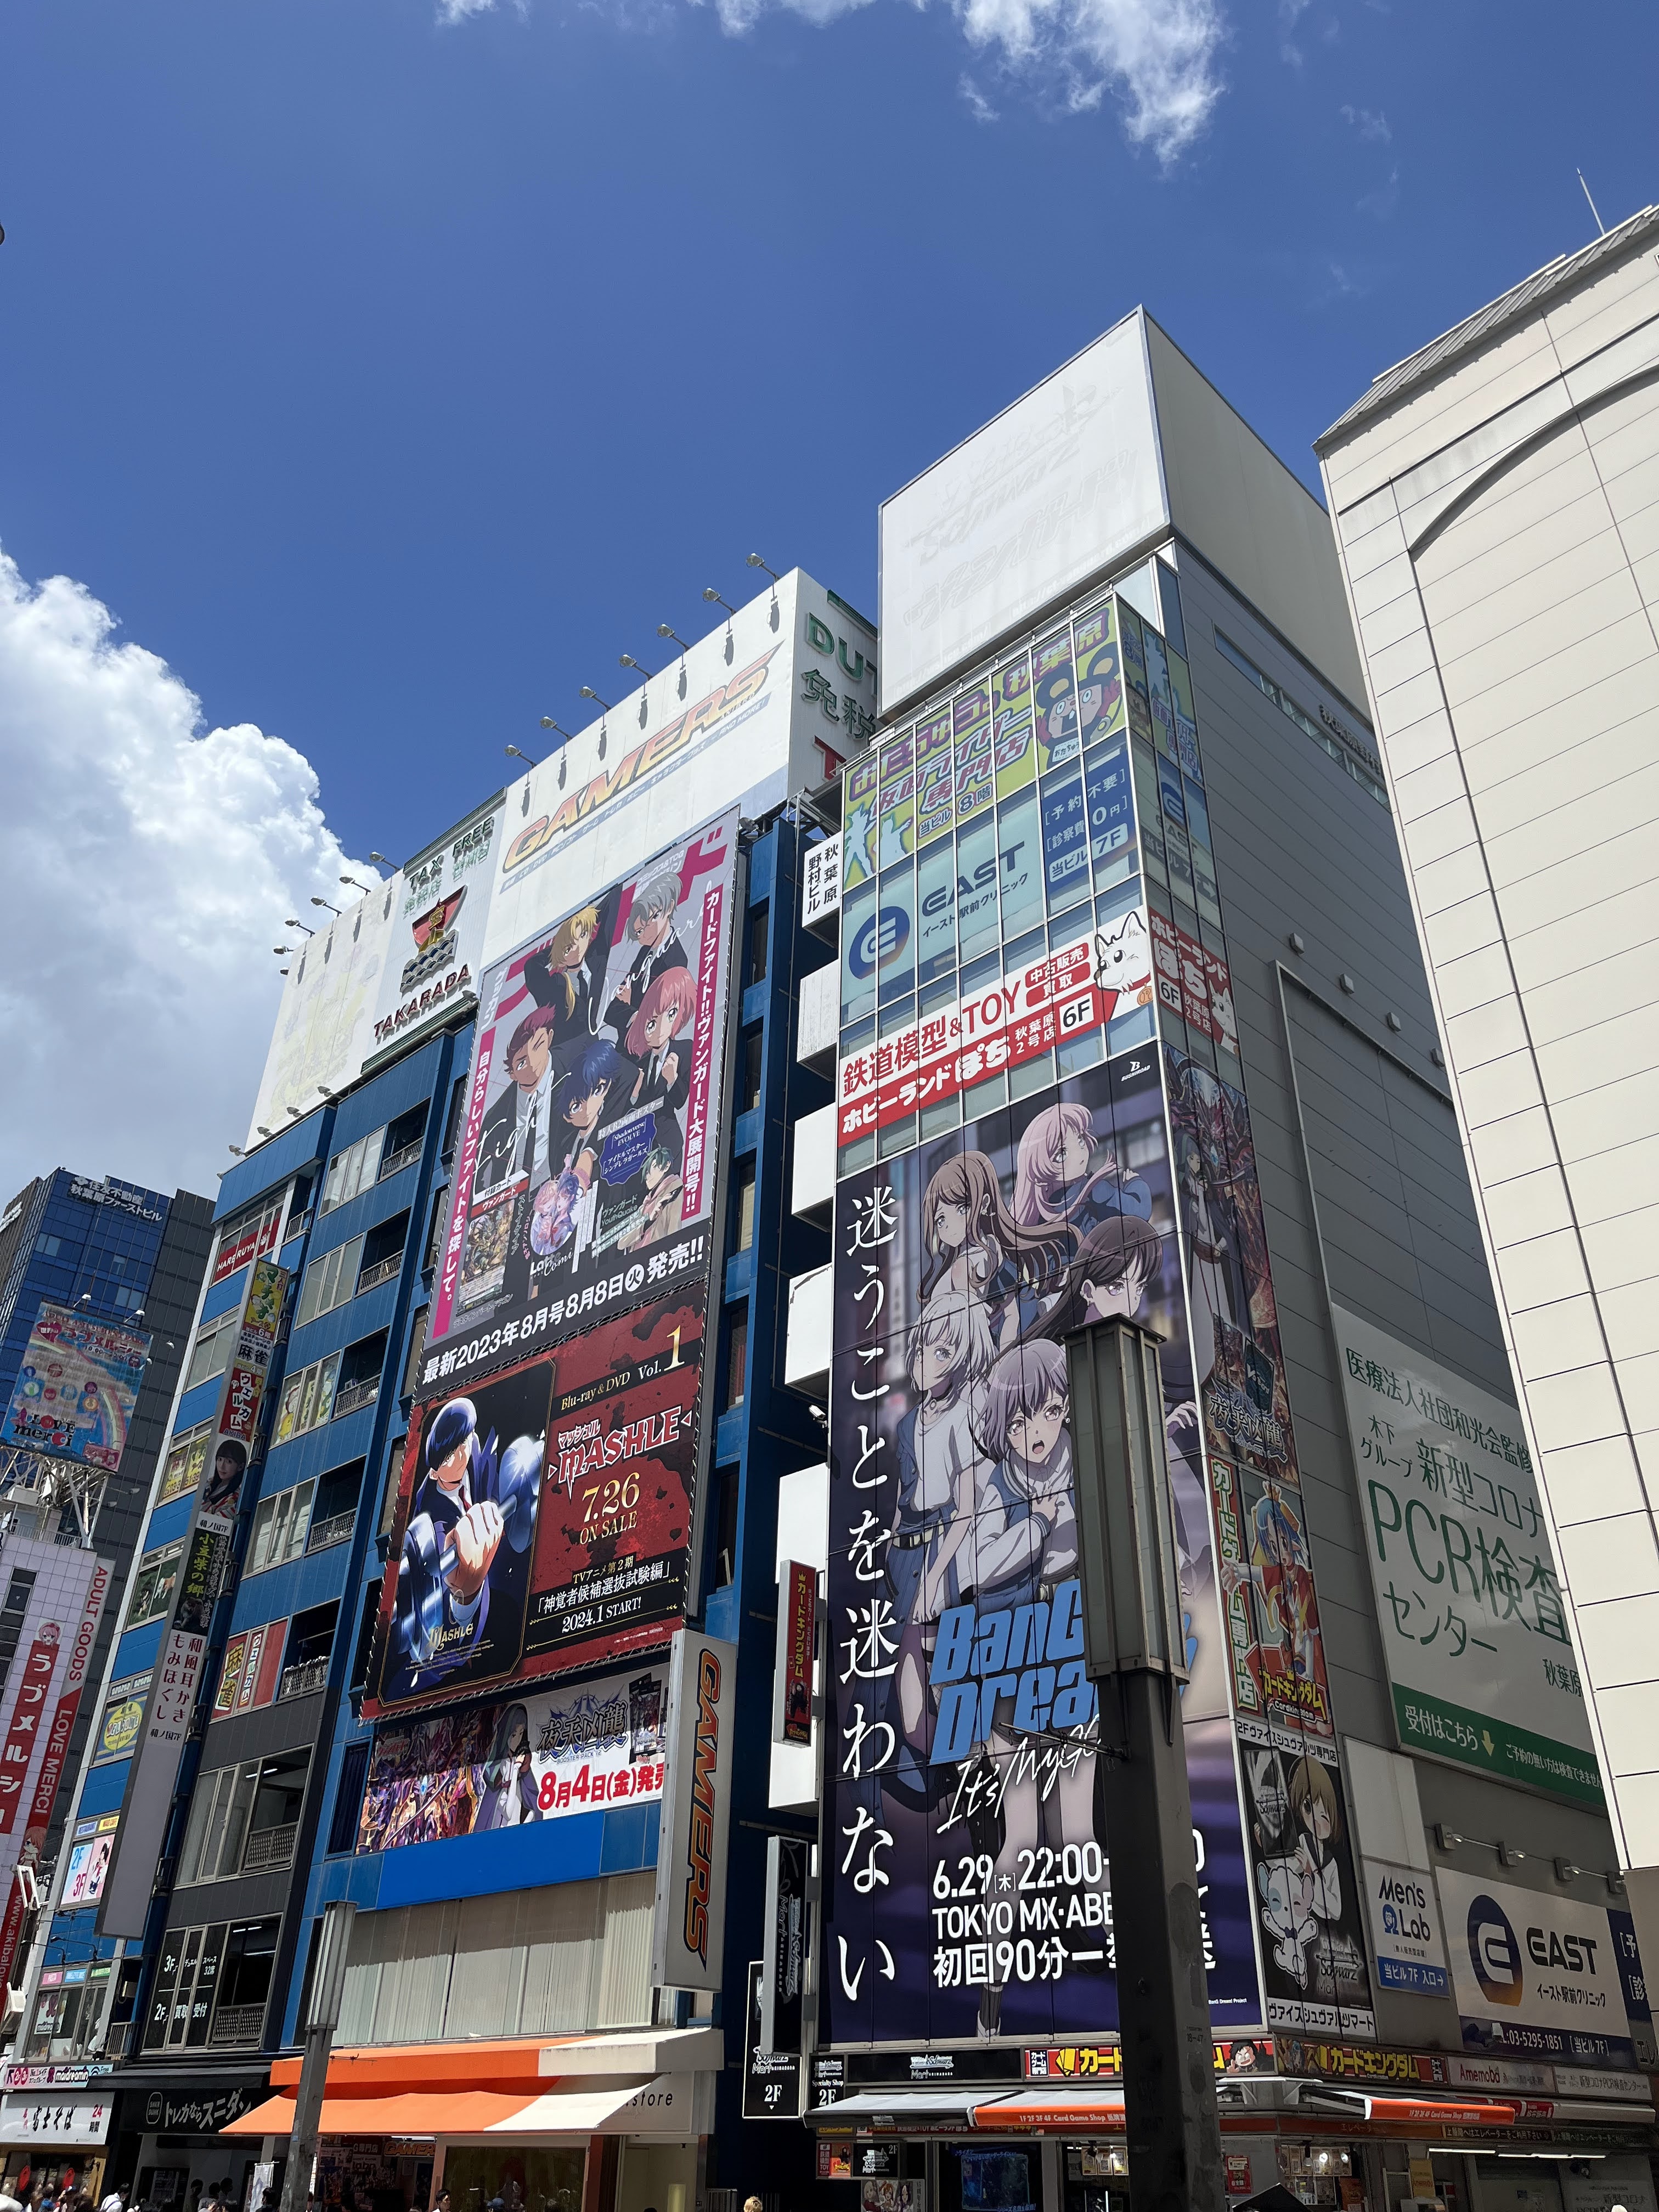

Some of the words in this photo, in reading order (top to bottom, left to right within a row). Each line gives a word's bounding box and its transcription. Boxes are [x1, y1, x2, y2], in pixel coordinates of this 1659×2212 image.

[1007, 613, 1106, 696] 秋葉原
[504, 640, 786, 874] GAMERS
[874, 708, 1032, 817] 仮面ライダー
[923, 728, 1030, 813] 専門店
[919, 810, 952, 837] 当ビル
[958, 783, 992, 815] 8階
[410, 854, 442, 889] TAX
[452, 815, 493, 858] FREE
[534, 854, 549, 868] DVD
[583, 820, 599, 834] ゲーム
[605, 799, 624, 816] トレカ
[823, 842, 839, 905] 秋葉原
[1052, 850, 1088, 878] 当ビル
[1096, 831, 1126, 856] 7F
[807, 855, 822, 915] 野村ビル
[922, 840, 1025, 917] EAST
[923, 873, 1028, 938] イースト駅前クリニック
[1029, 947, 1085, 984] 中古販売
[1043, 974, 1074, 996] 買取
[373, 963, 471, 1038] TAKARADA
[1160, 982, 1180, 1005] 6F
[1015, 1011, 1055, 1040] 秋葉原
[1062, 1000, 1091, 1029] 6F
[1016, 1027, 1057, 1054] 2号店
[843, 1064, 952, 1133] ホビーランド
[955, 1036, 1012, 1083] ぽち
[443, 1051, 491, 1301] 自分らしいファイトを探して。
[70, 1183, 163, 1222] 秋葉原ファーストビル
[482, 1185, 517, 1211] ヴァンガード
[601, 1205, 639, 1227] YouthQuake
[602, 1194, 639, 1218] ヴァンガード
[217, 1240, 256, 1272] HARERUYA
[236, 1344, 269, 1367] 麻雀
[561, 1386, 596, 1410] Blu-ray
[606, 1372, 631, 1393] DVD
[637, 1362, 662, 1380] Vol.
[663, 1325, 686, 1372] 1
[224, 1429, 246, 1441] AKIBA
[558, 1419, 600, 1448] マッシュル
[1370, 1414, 1396, 1447] 木下
[557, 1405, 684, 1504] MASHLE
[1361, 1436, 1413, 1479] グループ
[582, 1471, 641, 1524] 7.26
[579, 1523, 599, 1546] ON
[600, 1510, 638, 1538] SALE
[1368, 1477, 1573, 1646] PCR検査
[85, 1565, 109, 1619] ADULT
[837, 1186, 899, 2001] 迷うことを迷わない
[561, 1606, 604, 1634] 2024.1
[606, 1595, 642, 1619] START!
[794, 1582, 806, 1678] カードキングダム
[1383, 1581, 1498, 1658] センター
[69, 1621, 95, 1682] GOODS
[155, 1633, 185, 1720] もみほぐし
[172, 1637, 204, 1724] 和風耳かき
[49, 1709, 73, 1754] LOVE
[1404, 1705, 1479, 1752] 受付はこちら
[556, 1754, 579, 1764] BOOSTER
[580, 1751, 594, 1759] PACK
[34, 1756, 61, 1814] MERCI
[684, 1647, 721, 1972] GAMERS
[71, 1847, 83, 1870] 2F
[933, 1855, 994, 1900] 6.29
[72, 1872, 86, 1897] 3F
[1378, 1875, 1426, 1909] Men's
[932, 1899, 1013, 1940] TOKYO
[1399, 1909, 1431, 1942] Lab
[163, 1955, 176, 1972] 3F
[1526, 1927, 1598, 1976] EAST
[1384, 1962, 1407, 1979] 当ビル
[1408, 1967, 1418, 1983] 7F
[154, 2003, 166, 2021] 2F
[1537, 1983, 1606, 2008] イースト駅前クリニック
[54, 2066, 89, 2083] maidreamin
[1031, 2051, 1046, 2059] カード
[1031, 2059, 1047, 2068] ゲーム
[1330, 2046, 1420, 2080] カードキングダム
[1460, 2063, 1500, 2084] Amemoba
[92, 2103, 104, 2118] 24
[764, 2084, 783, 2103] 2F
[819, 2089, 837, 2106] 2F
[1053, 2113, 1068, 2123] Card
[1069, 2114, 1088, 2123] Game
[1089, 2113, 1106, 2124] Shop
